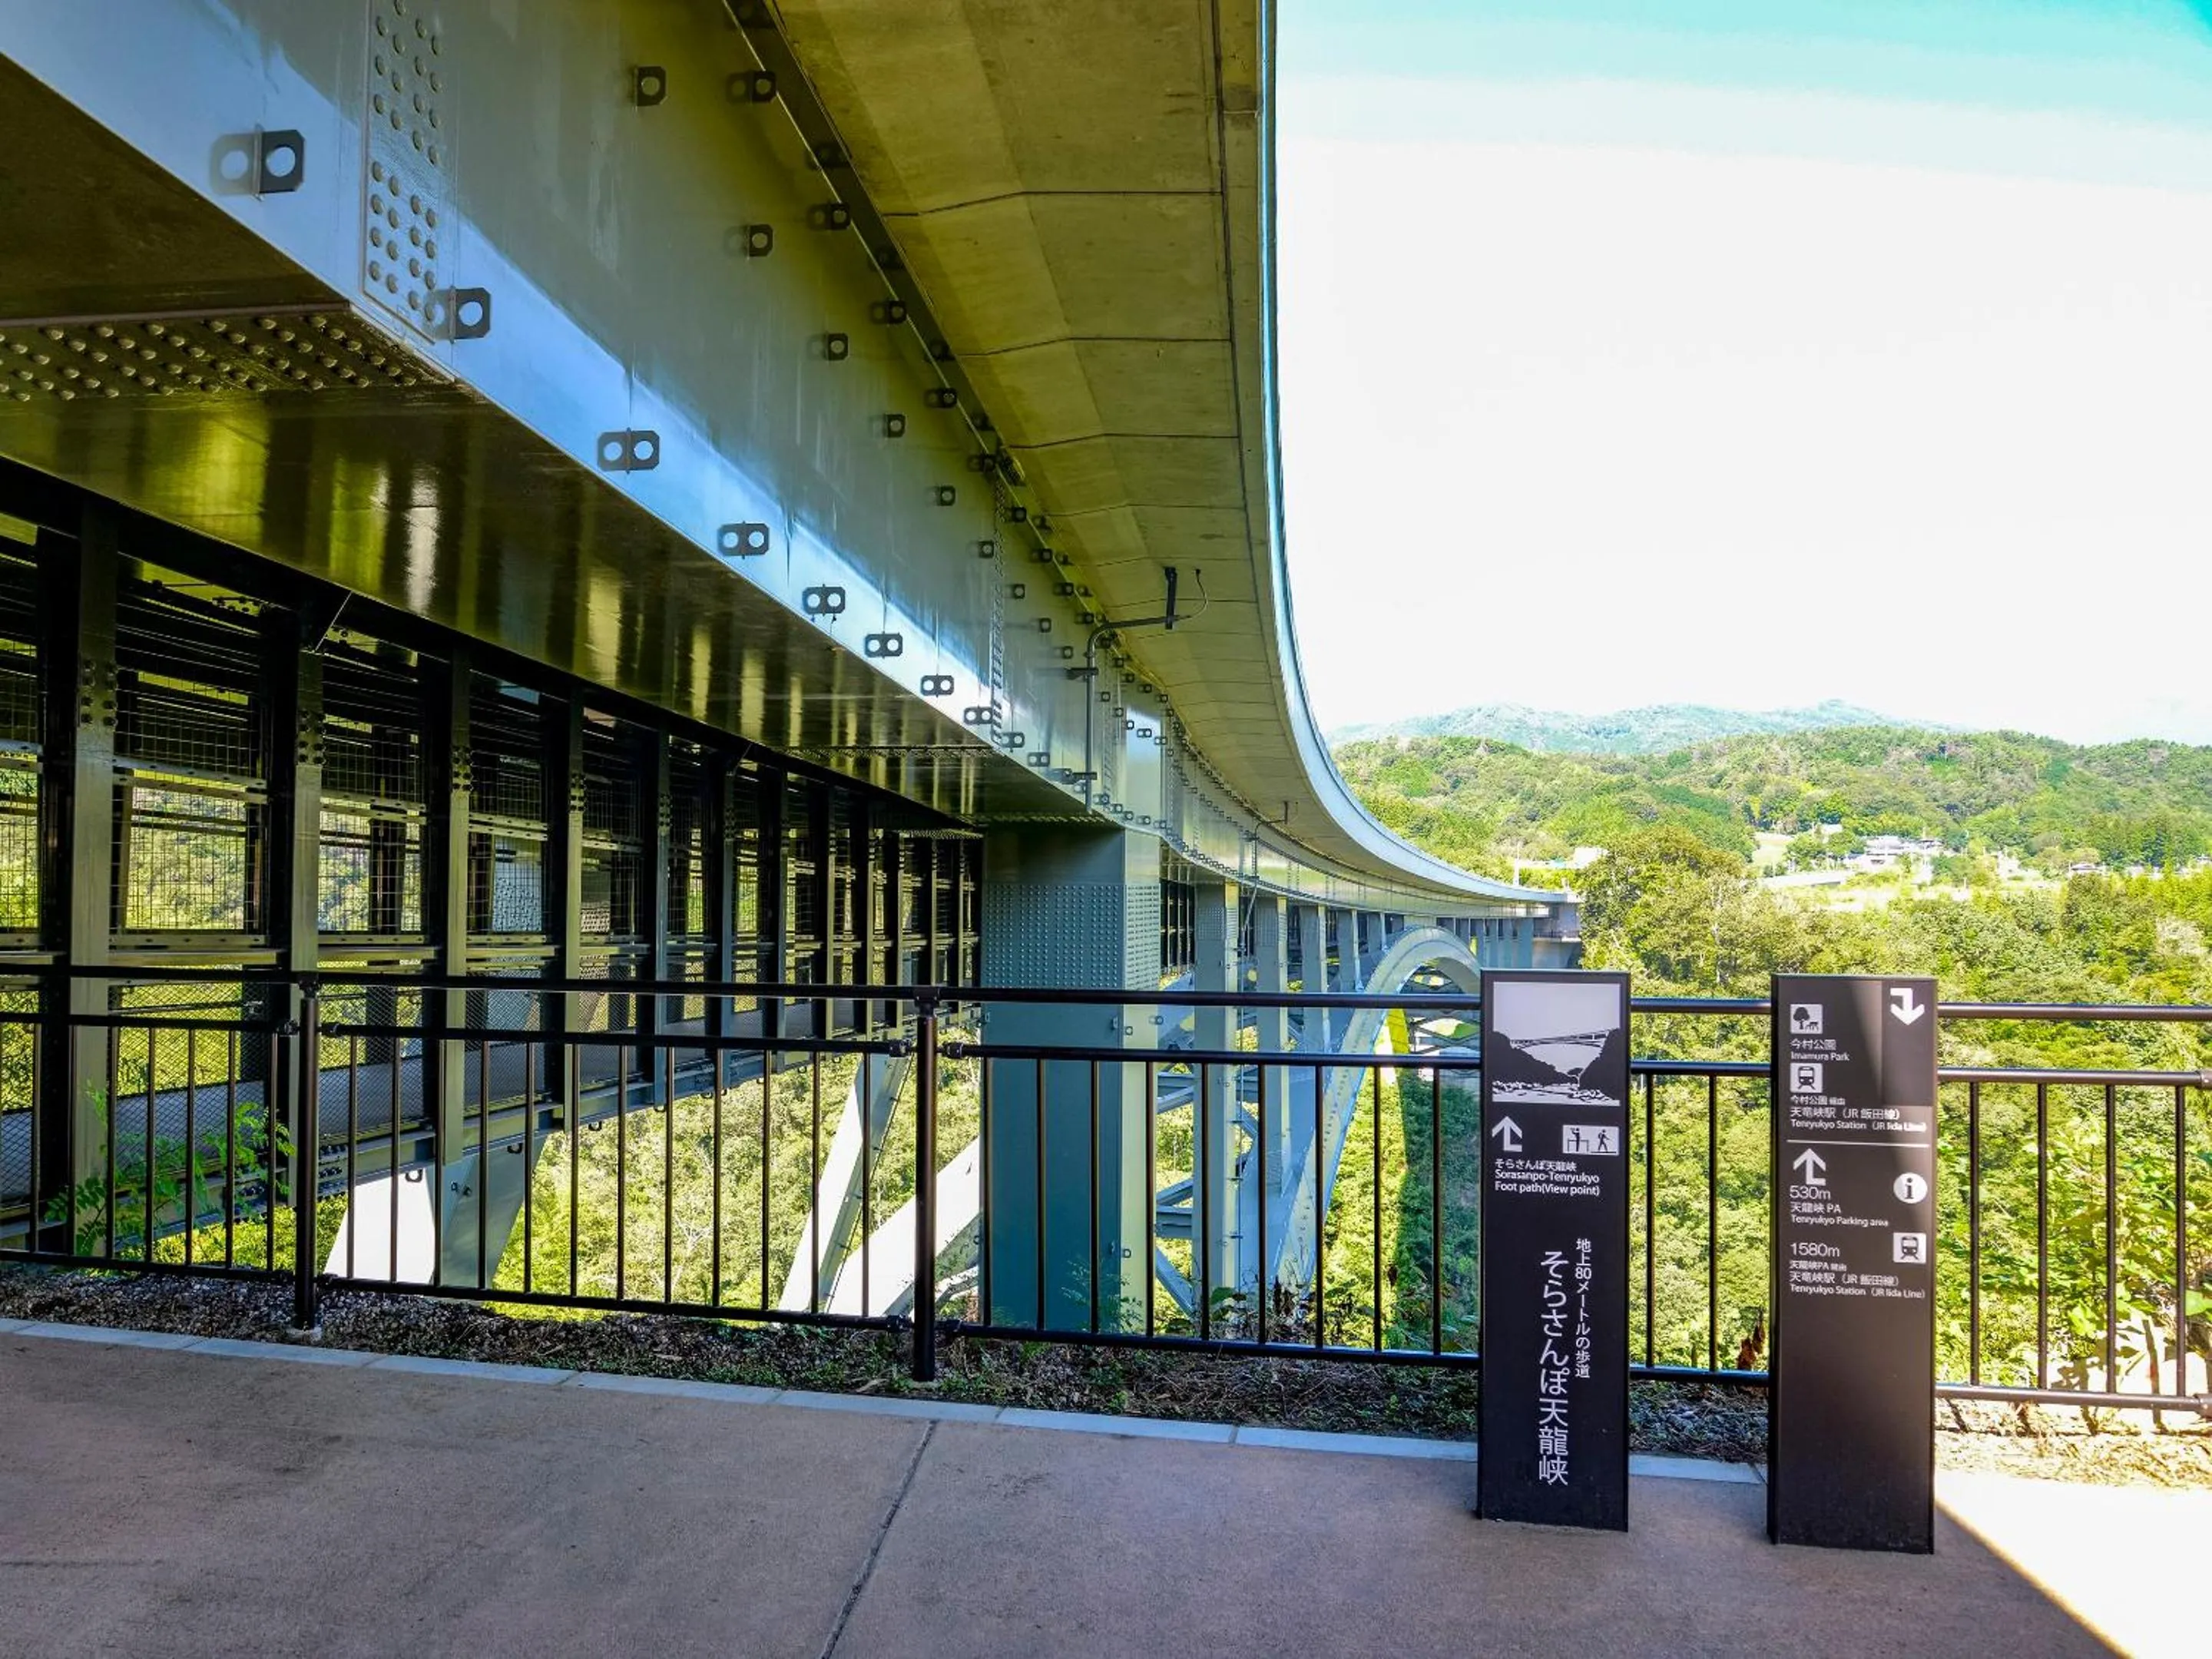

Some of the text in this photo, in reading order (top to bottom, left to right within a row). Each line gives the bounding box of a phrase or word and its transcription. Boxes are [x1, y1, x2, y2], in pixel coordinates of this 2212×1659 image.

[1790, 1039, 1836, 1050] 今村公園
[1791, 1052, 1849, 1061] Imamura Park
[1790, 1095, 1827, 1105] 今村公園
[1791, 1119, 1835, 1130] Tenryukyo
[1836, 1121, 1866, 1129] Station
[1495, 1170, 1599, 1184] Sorasanpo-Tenryukyo
[1495, 1181, 1517, 1191] Foot
[1570, 1185, 1599, 1196] point)
[1790, 1185, 1831, 1199] 530m
[1792, 1215, 1835, 1225] Tenryukyo
[1837, 1217, 1868, 1227] Parking
[1790, 1242, 1840, 1257] 1580m
[1791, 1284, 1834, 1295] Tenryukyo
[1836, 1286, 1866, 1296] Station
[1575, 1238, 1592, 1378] 地上80メートルの歩道
[1539, 1251, 1570, 1486] そらさんぽ天龍峡
